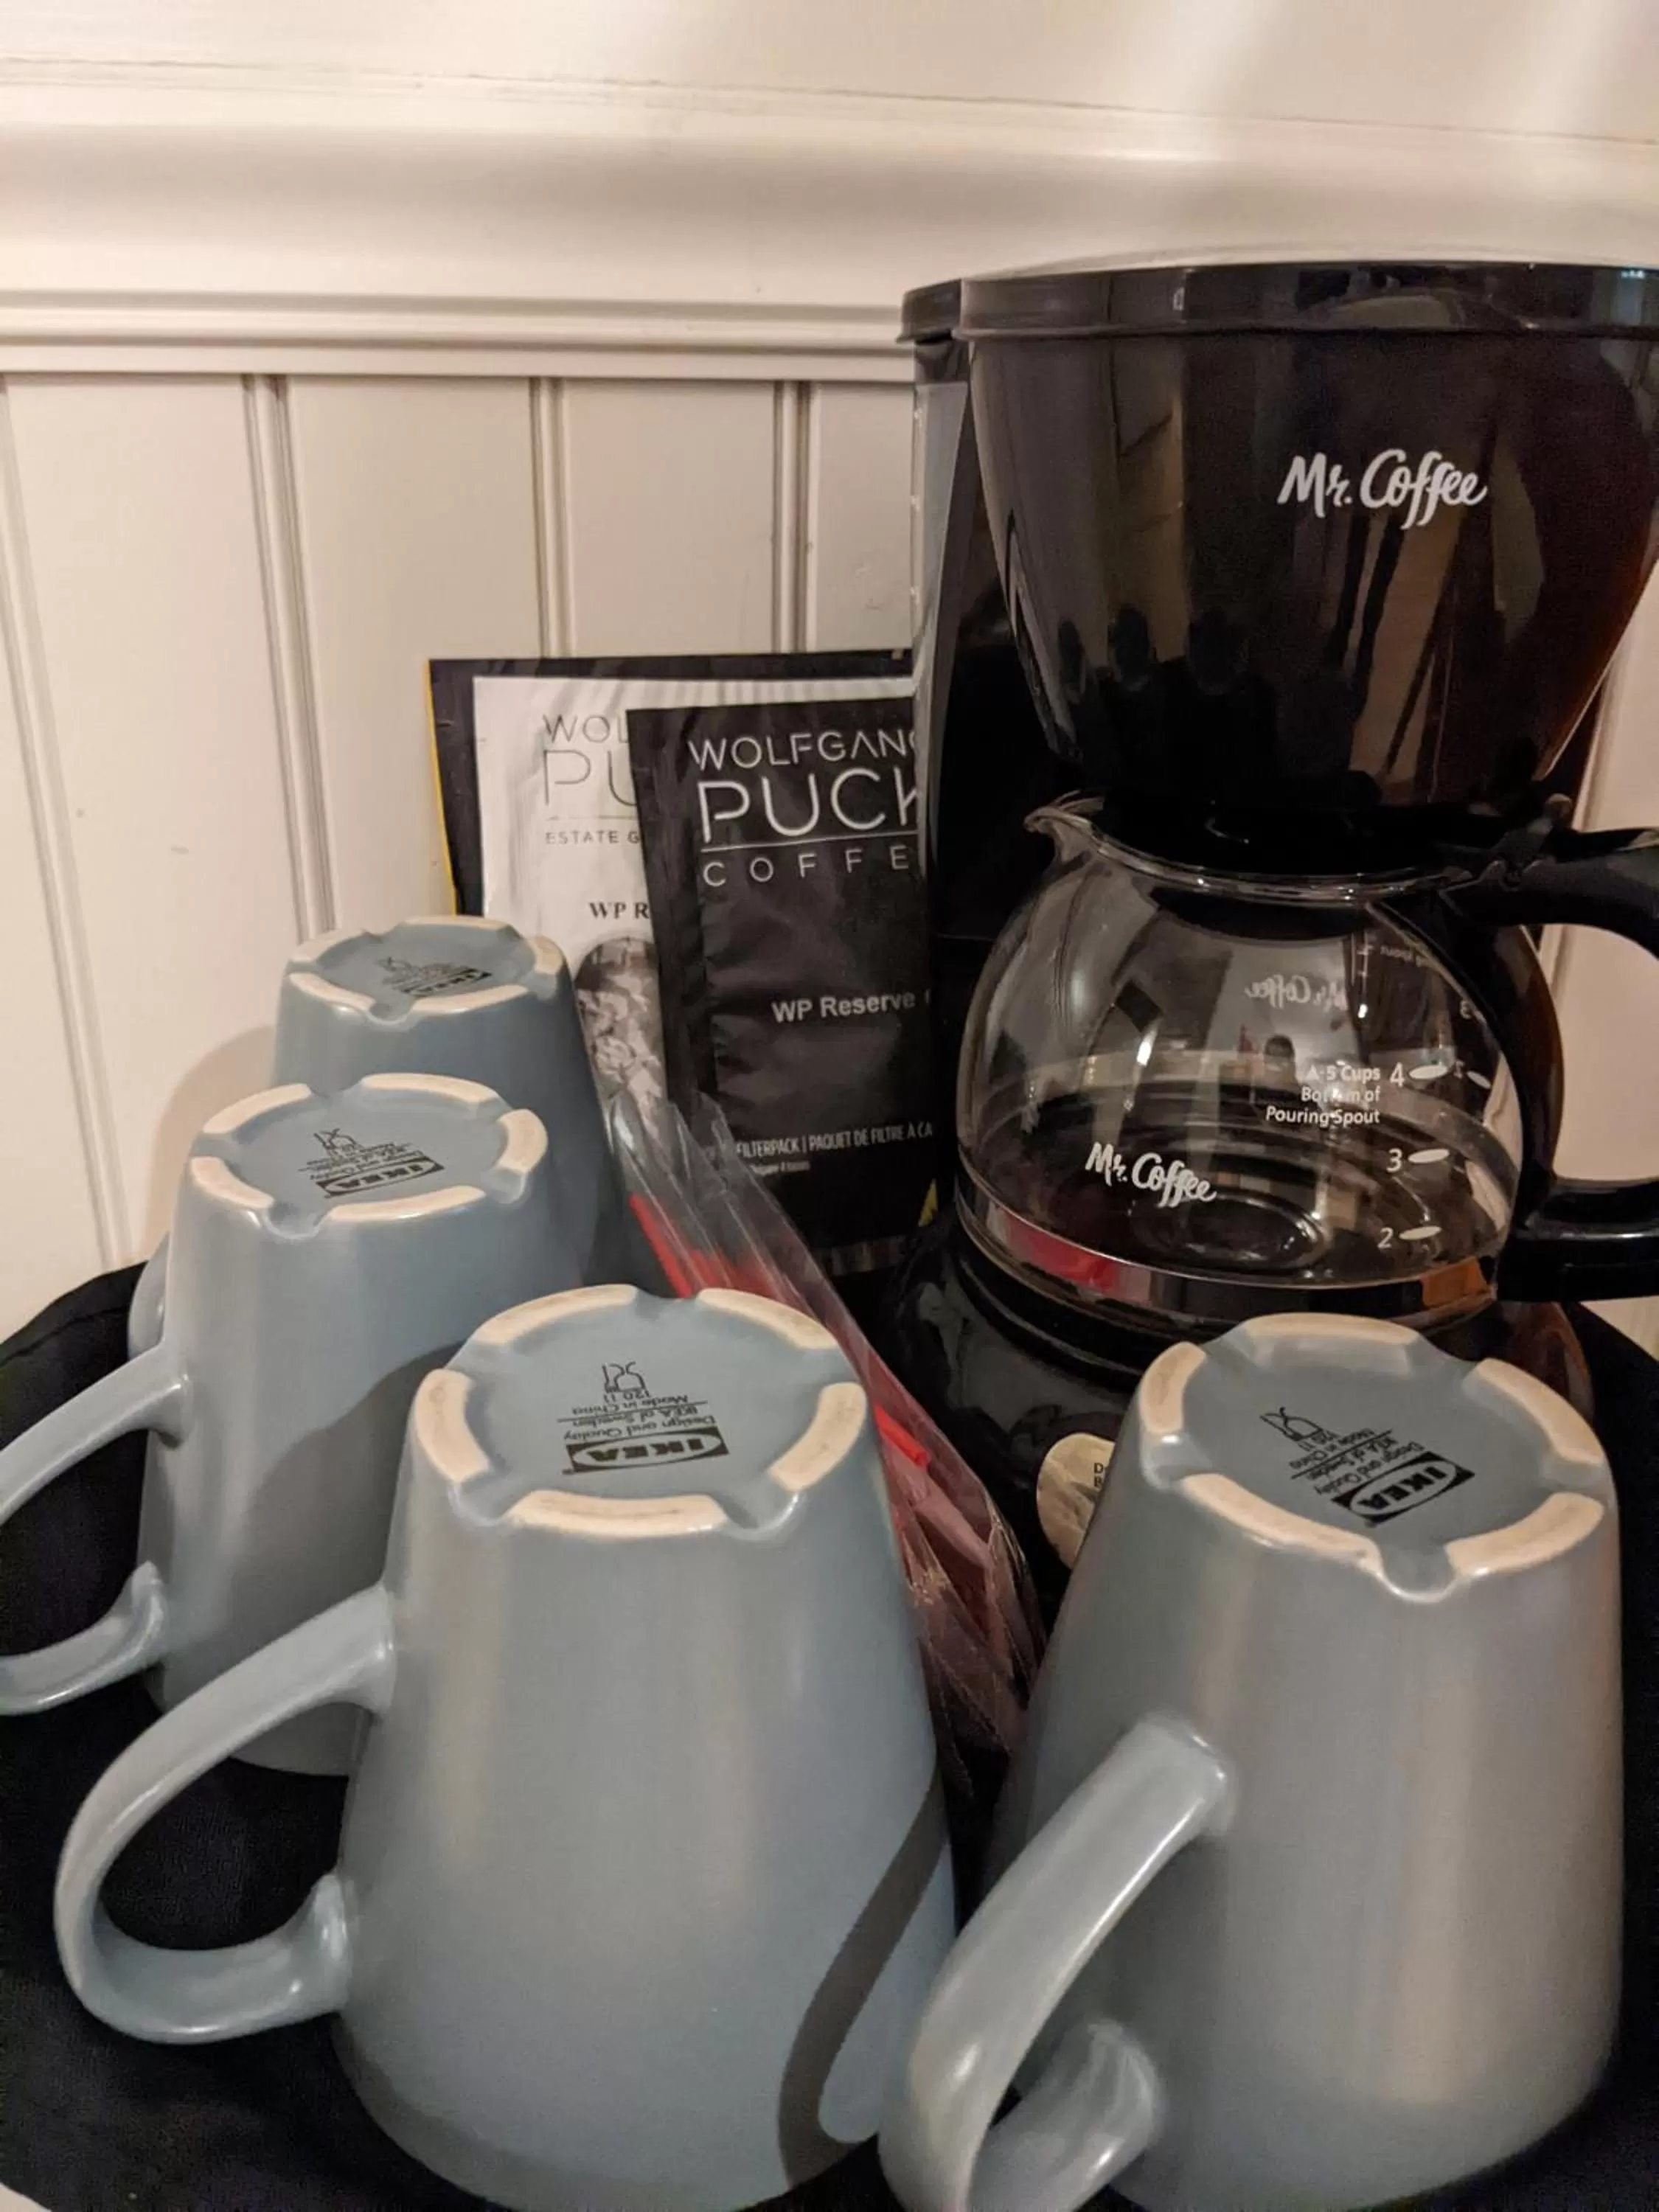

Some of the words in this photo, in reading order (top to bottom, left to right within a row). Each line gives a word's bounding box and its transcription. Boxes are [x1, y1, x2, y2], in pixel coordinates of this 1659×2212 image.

[1277, 452, 1352, 518] Mr.
[1360, 448, 1488, 530] Coffee
[688, 728, 915, 771] WOLFGAN
[545, 830, 619, 844] ESTATE
[589, 902, 627, 919] WP
[771, 998, 813, 1023] WP
[819, 991, 916, 1018] Reserve
[1340, 1064, 1381, 1085] Cups
[1389, 1061, 1405, 1088] 4
[1365, 1085, 1381, 1102] of
[1265, 1105, 1328, 1129] Pouring
[1334, 1108, 1381, 1128] Spout
[810, 1130, 851, 1152] PAQUET
[853, 1128, 869, 1148] DE
[1386, 1148, 1403, 1173] 3
[1085, 1141, 1128, 1187] Mr.
[1131, 1152, 1217, 1208] Coffee
[1377, 1228, 1393, 1249] 2
[586, 1438, 704, 1462] IKEA
[1357, 1466, 1447, 1510] IKEA
